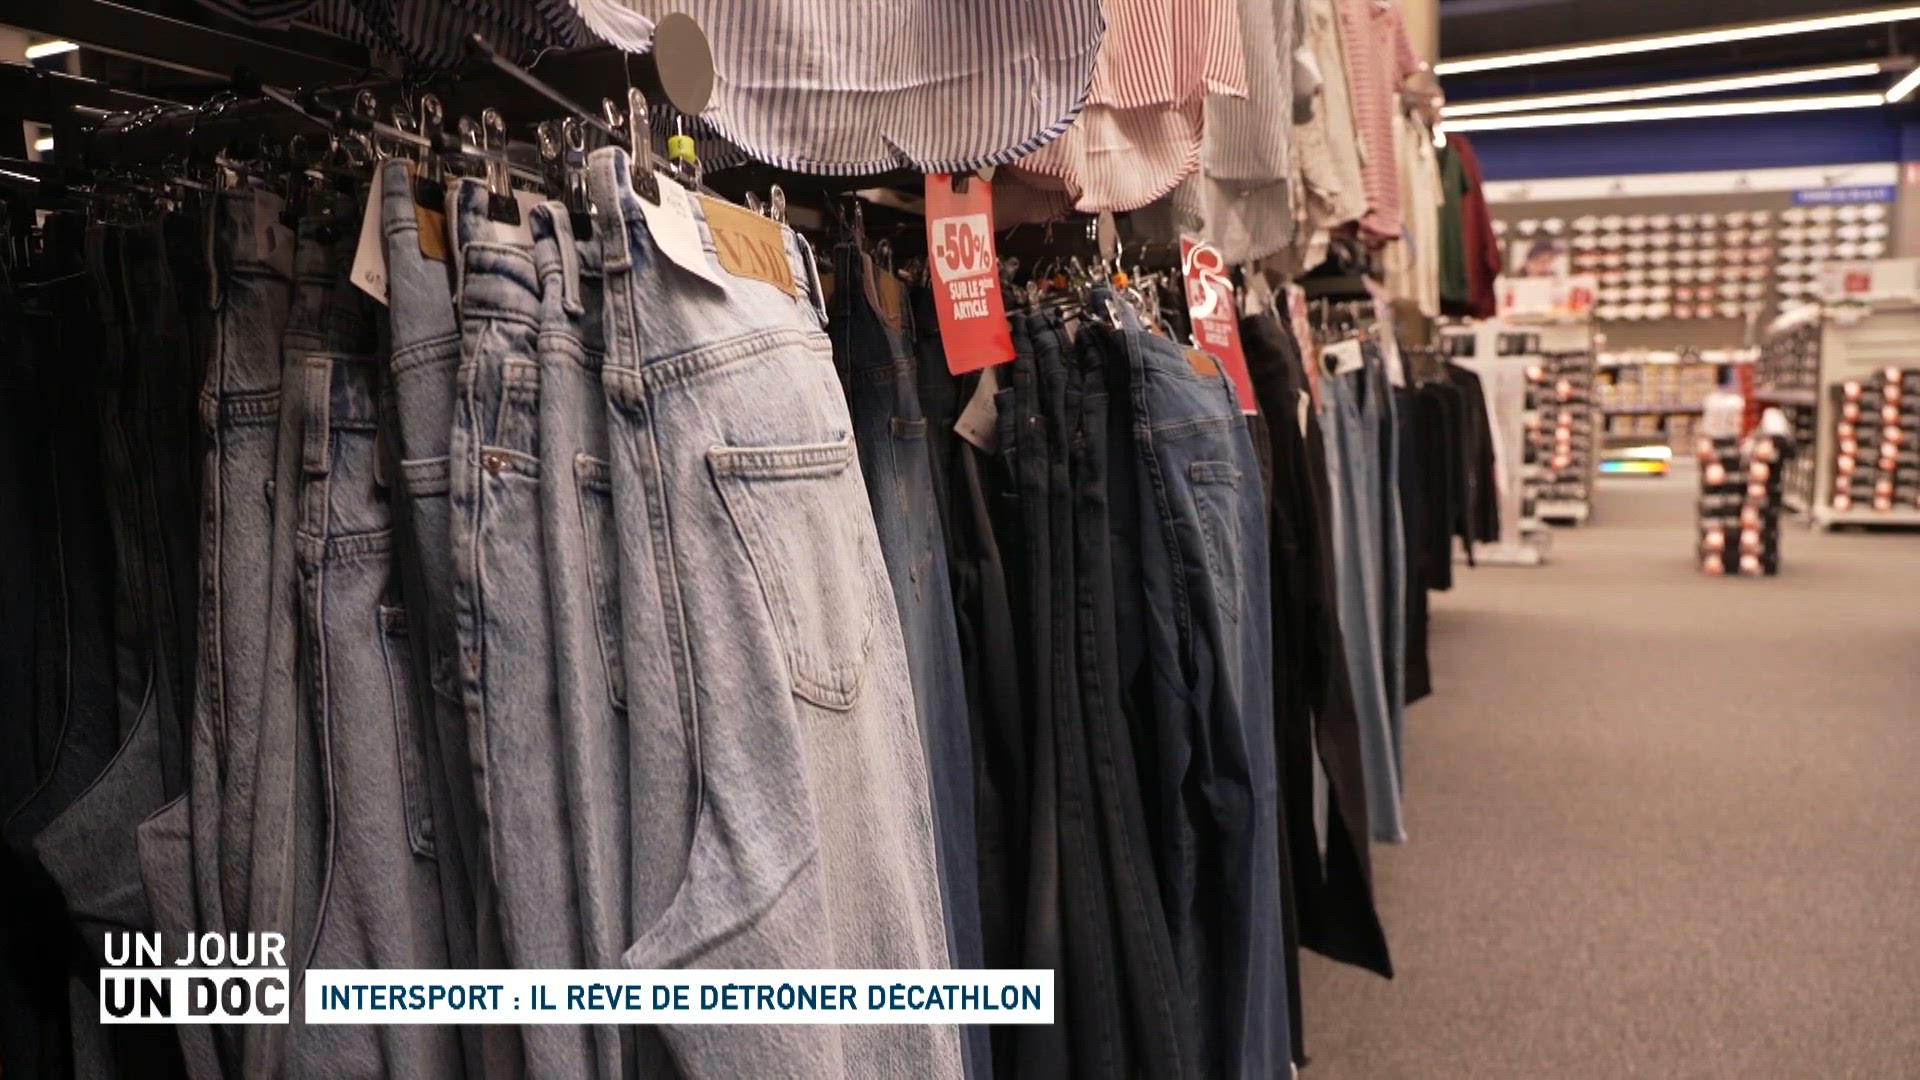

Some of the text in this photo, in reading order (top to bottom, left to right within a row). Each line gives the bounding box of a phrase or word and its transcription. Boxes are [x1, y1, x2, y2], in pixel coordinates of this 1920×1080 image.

[936, 222, 990, 271] -50%
[949, 281, 968, 300] SUR
[967, 280, 979, 298] LE
[953, 298, 989, 320] ARTICLE
